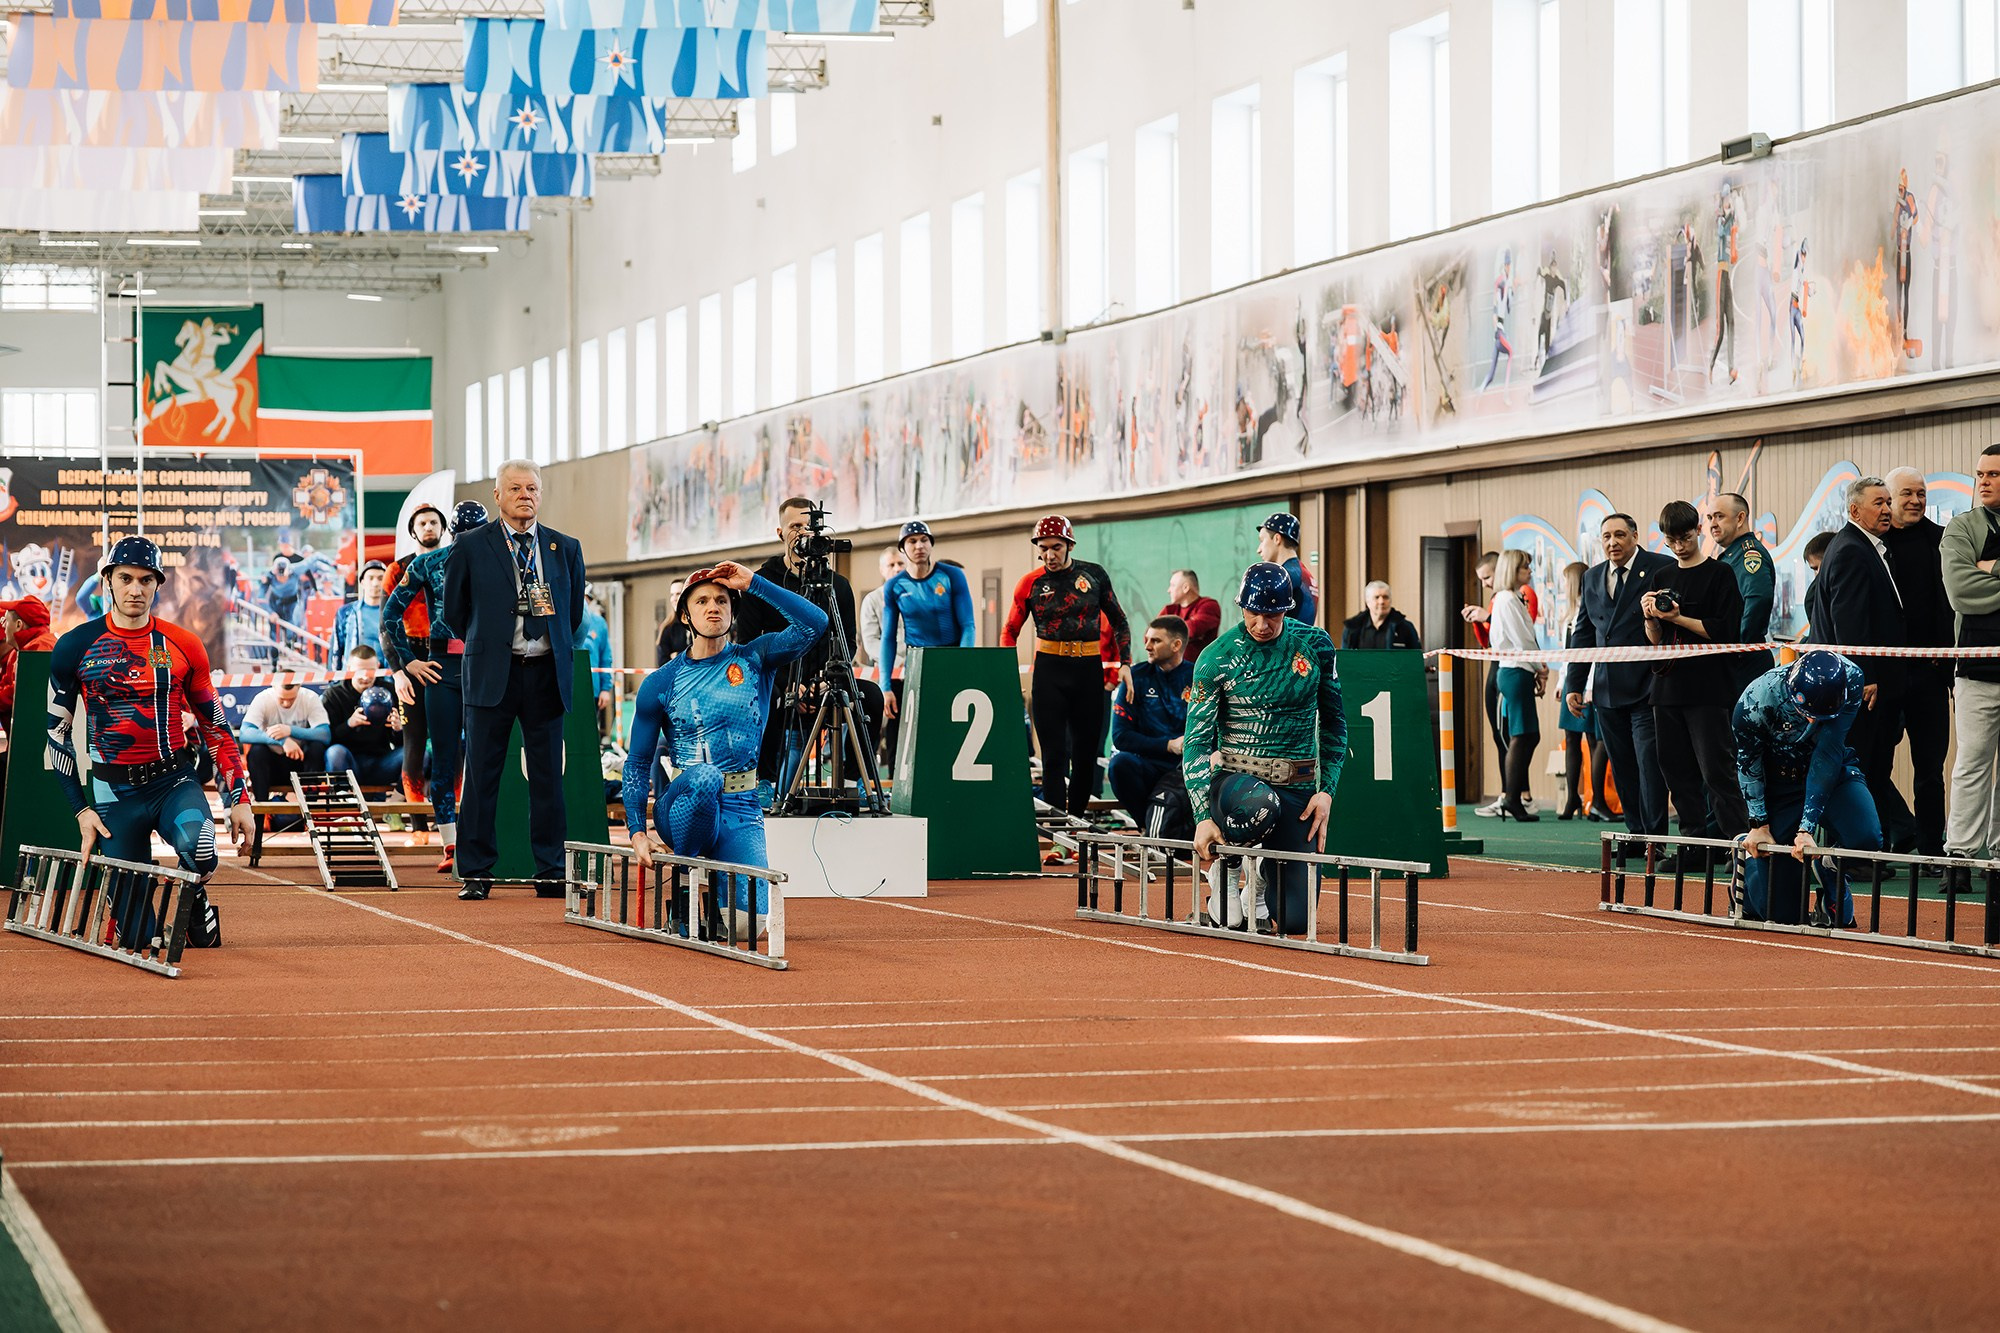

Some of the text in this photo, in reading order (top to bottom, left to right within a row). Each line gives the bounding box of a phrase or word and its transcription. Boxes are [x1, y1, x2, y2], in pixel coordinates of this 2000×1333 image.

[159, 470, 252, 486] СОРЕВНОВАНИЯ
[40, 489, 269, 506] ПО ПОЖАРНО-СПСАТЕЛЬНОМУ СПОРТУ
[185, 511, 215, 527] ФПС
[215, 511, 243, 527] МЧС
[244, 511, 291, 527] РОССИИ
[198, 533, 222, 549] год
[96, 657, 127, 665] POLYUS
[951, 688, 994, 781] 2
[1361, 690, 1393, 781] 1
